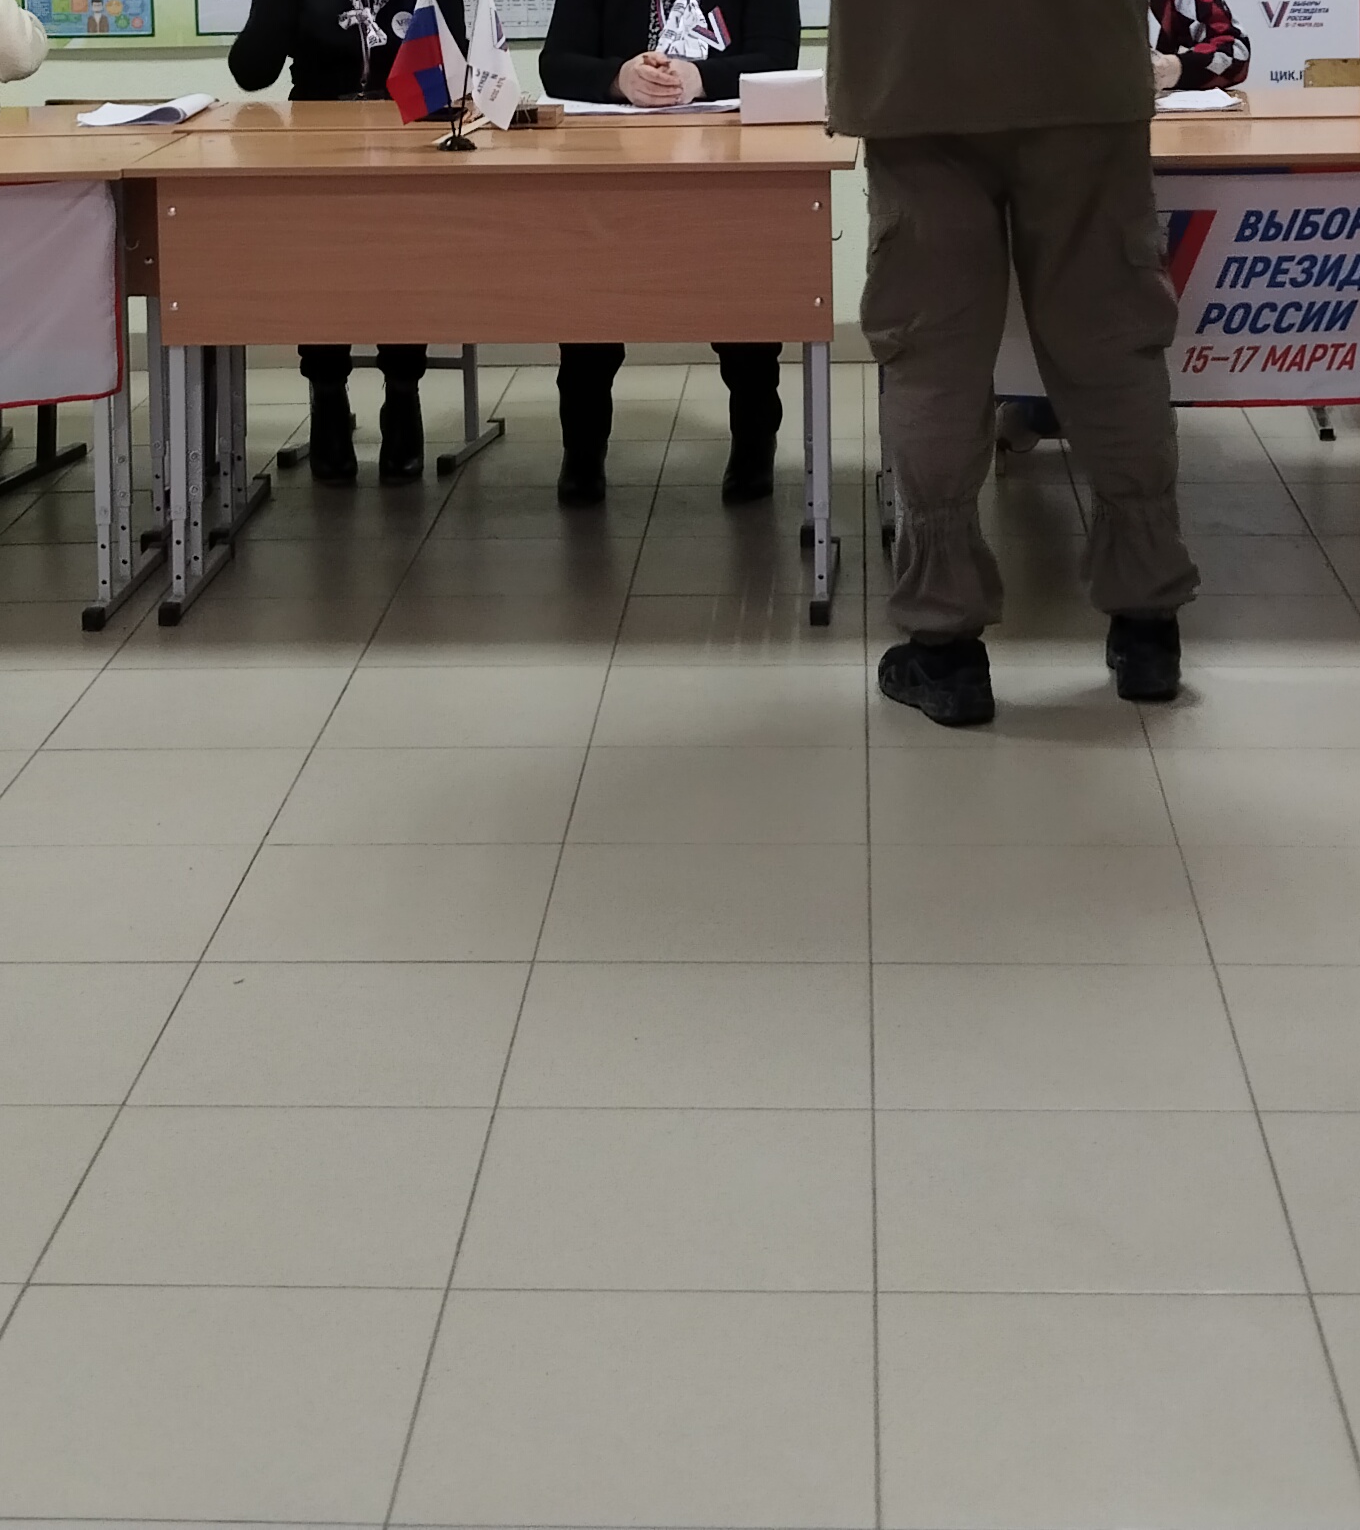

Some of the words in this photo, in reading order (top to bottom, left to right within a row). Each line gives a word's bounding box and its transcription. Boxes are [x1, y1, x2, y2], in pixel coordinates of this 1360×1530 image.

[1270, 70, 1304, 83] ЦИК.
[1194, 299, 1359, 335] РОССИИ
[1181, 345, 1260, 374] 15–17
[1260, 342, 1358, 373] МАРТА
